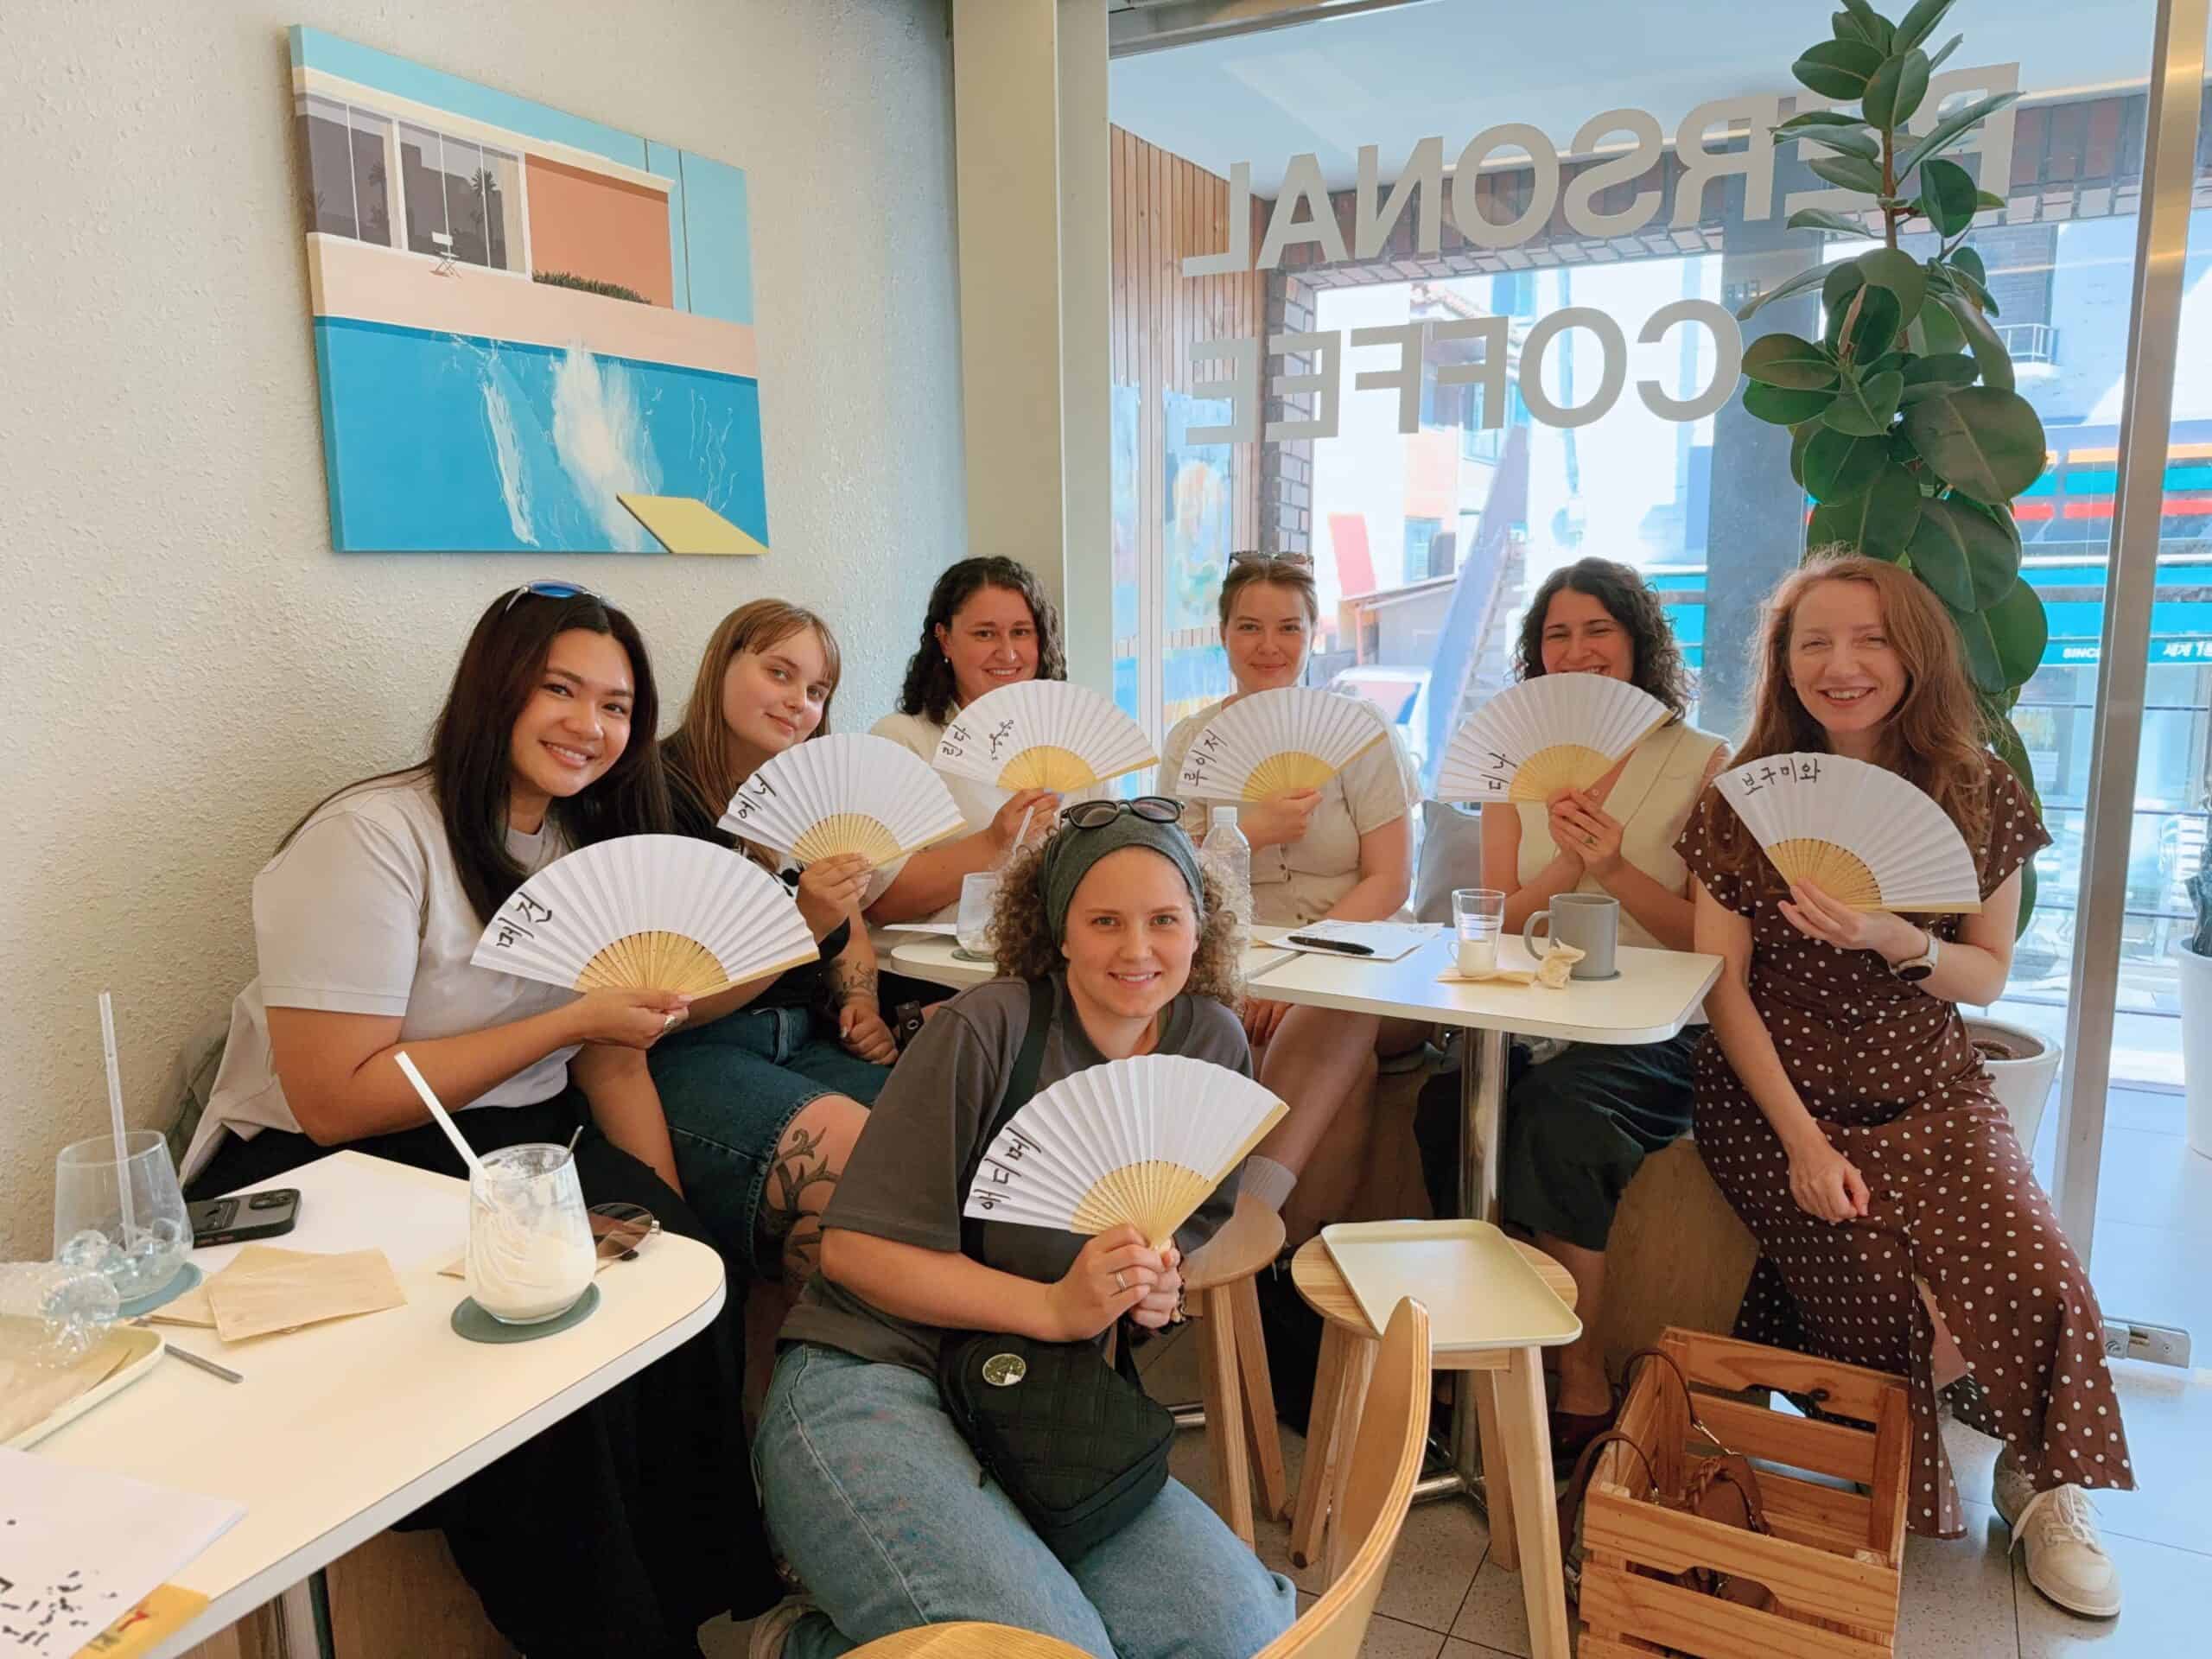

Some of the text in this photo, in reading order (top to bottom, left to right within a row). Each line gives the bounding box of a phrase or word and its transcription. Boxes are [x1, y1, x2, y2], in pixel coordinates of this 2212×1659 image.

[940, 724, 971, 758] 린다
[1183, 728, 1229, 787] 루이저
[1479, 753, 1518, 790] 디나
[495, 891, 552, 948] 메건
[973, 1126, 1042, 1210] 애디메
